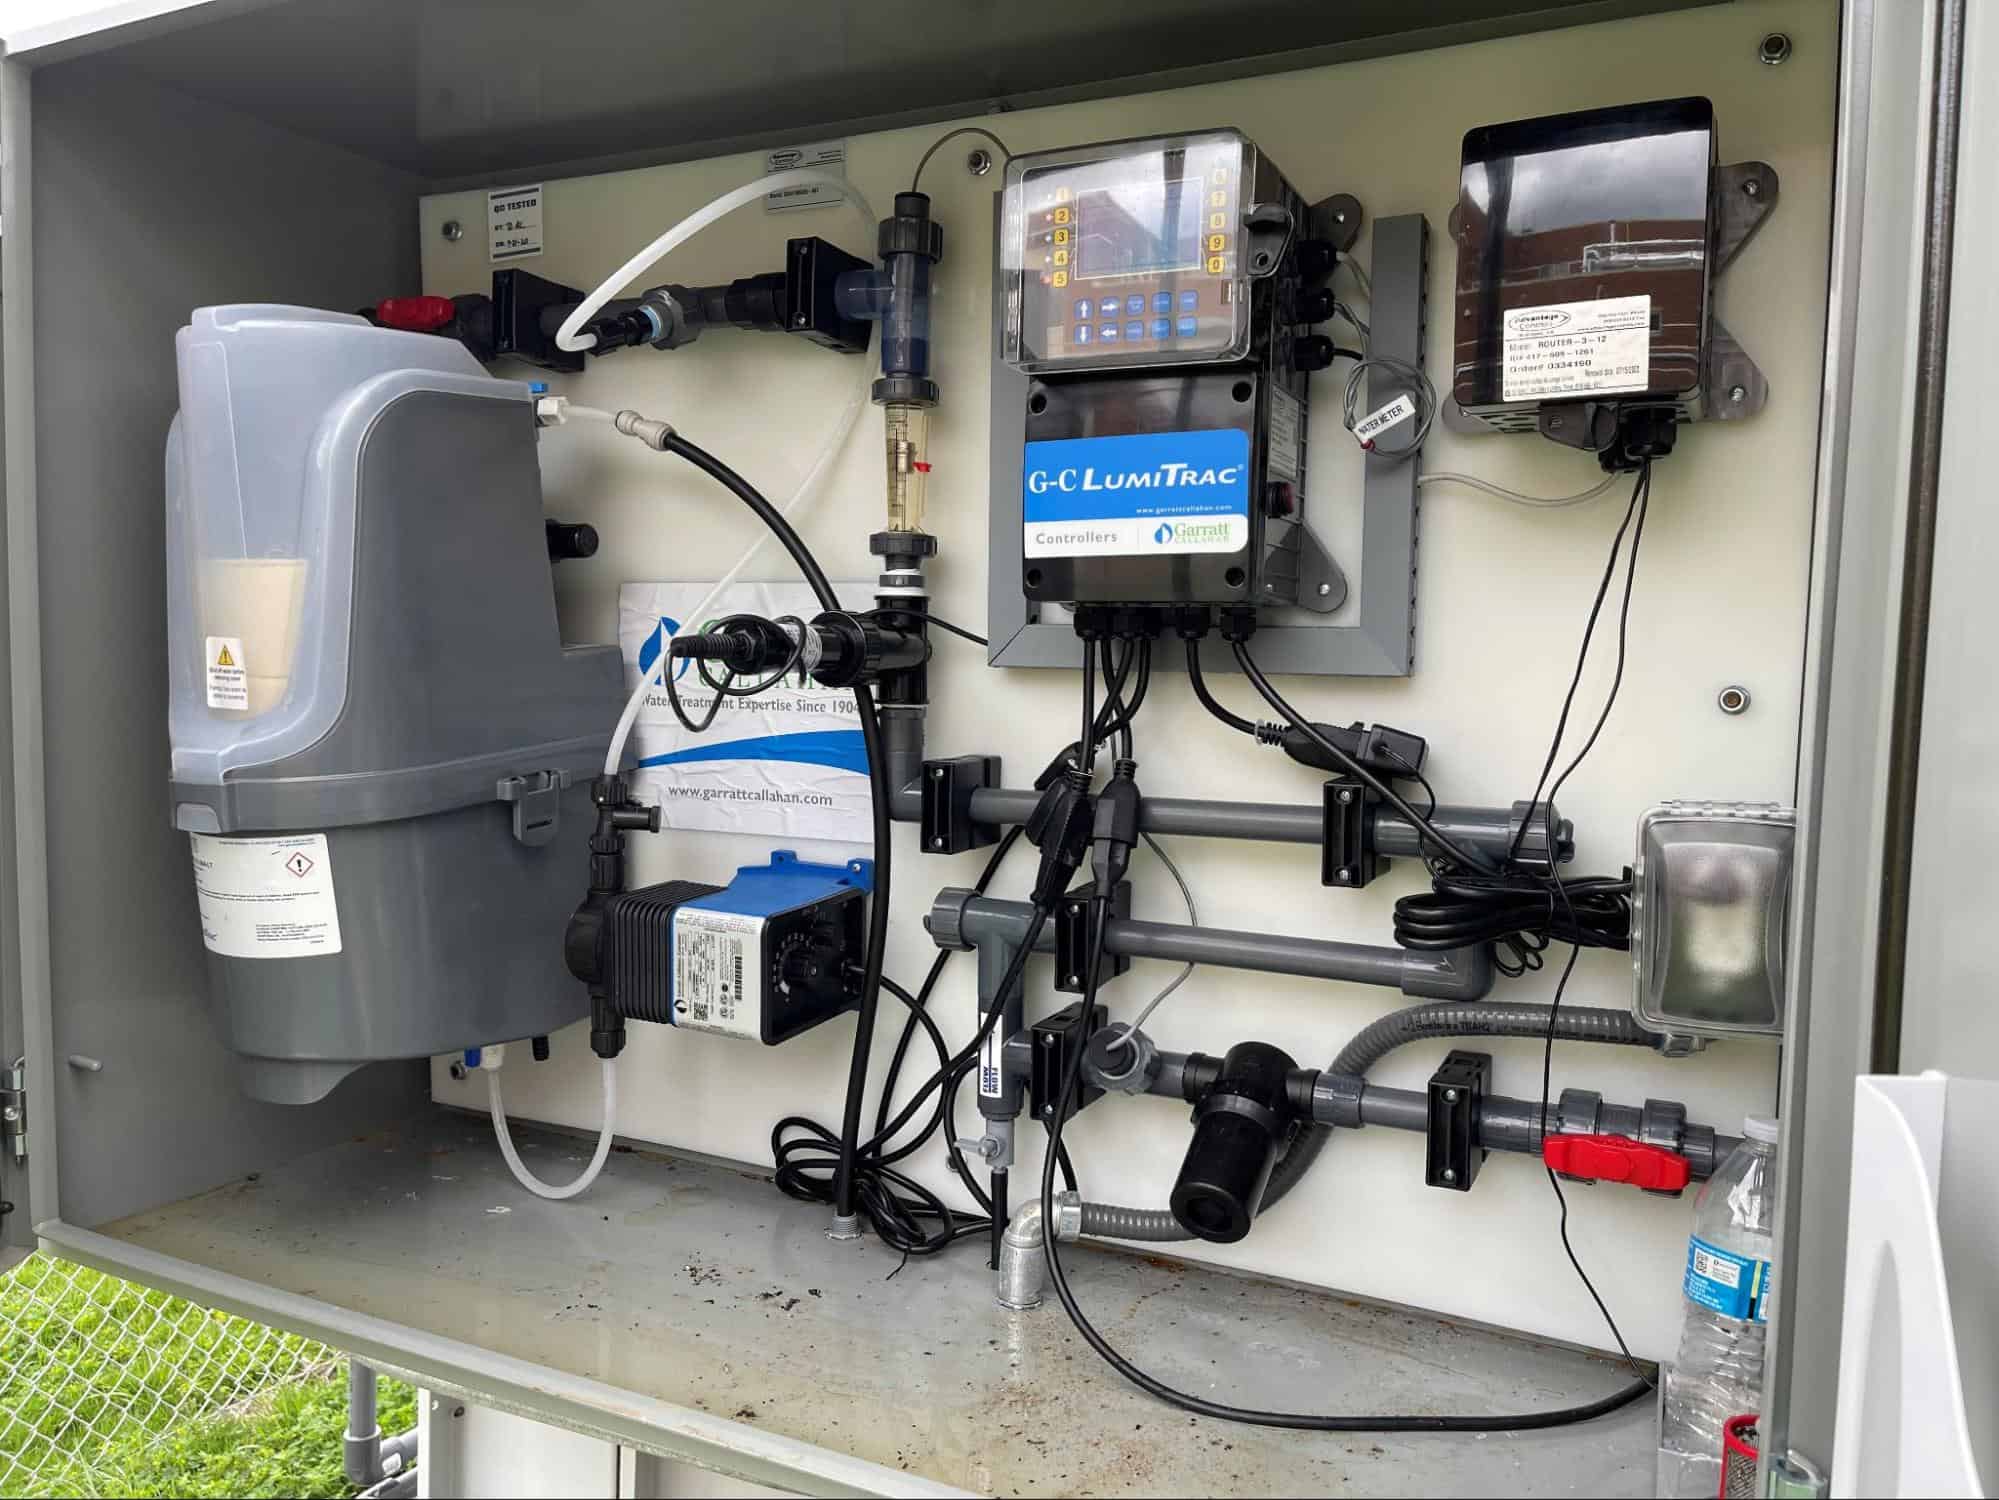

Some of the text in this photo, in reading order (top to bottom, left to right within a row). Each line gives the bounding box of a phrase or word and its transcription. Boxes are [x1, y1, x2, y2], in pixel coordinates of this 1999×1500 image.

[1058, 231, 1065, 243] 3
[1378, 404, 1404, 424] METER
[1028, 467, 1077, 494] G-C
[1035, 531, 1118, 545] Controllers
[738, 696, 792, 714] Expertise
[796, 698, 826, 713] Since
[668, 784, 833, 807] www.garrattcallahan.com
